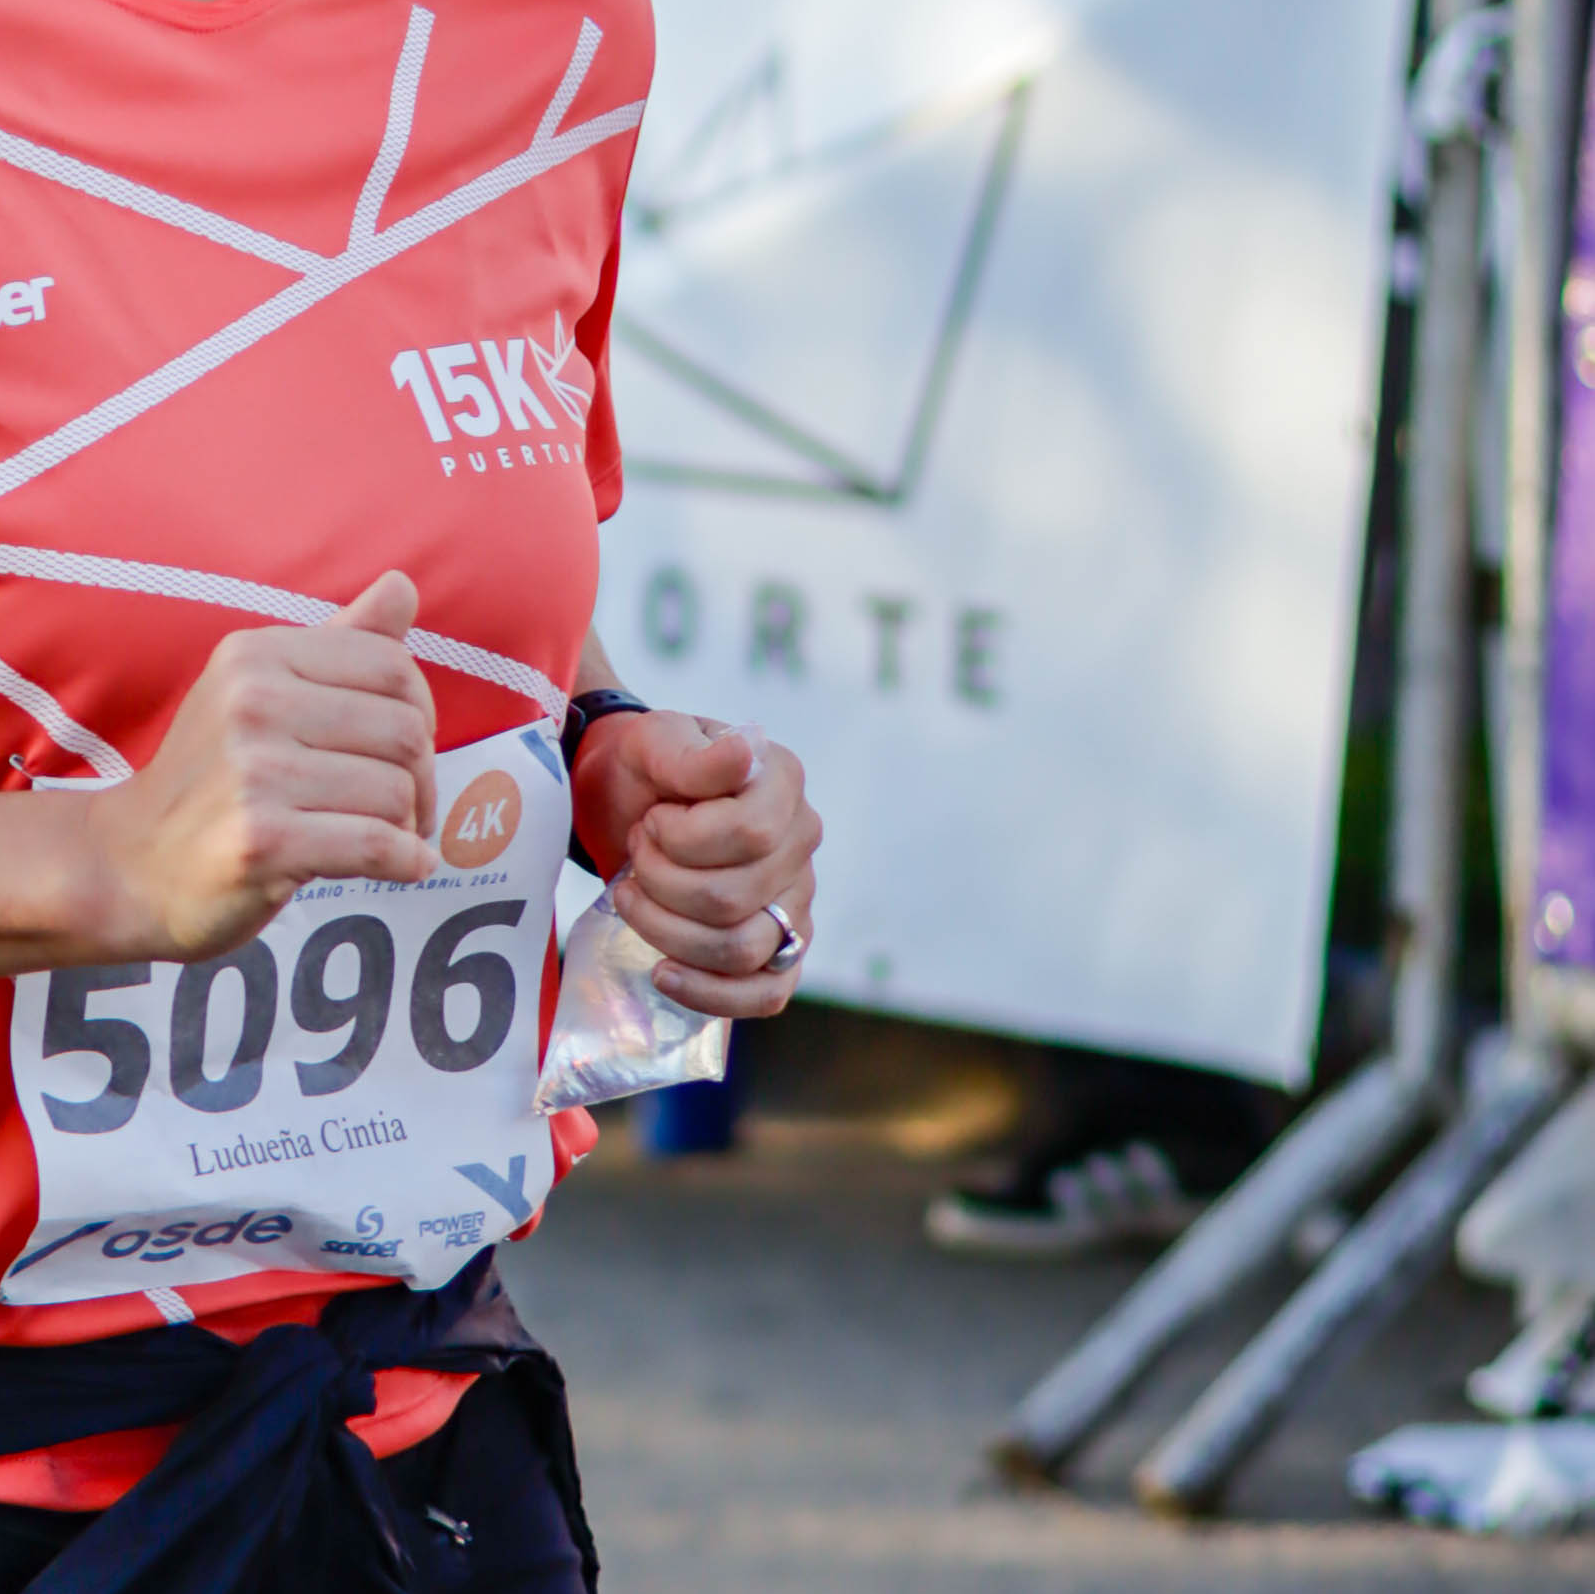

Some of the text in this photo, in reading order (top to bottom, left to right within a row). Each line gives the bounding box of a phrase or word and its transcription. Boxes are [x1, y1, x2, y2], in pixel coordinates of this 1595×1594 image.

[390, 337, 558, 443] 15K
[456, 798, 509, 843] 4K
[414, 877, 462, 891] ABRIL
[41, 900, 527, 1134] 5096
[187, 1110, 408, 1176] Ludueña Cintia
[102, 1210, 294, 1263] osde
[419, 1211, 485, 1237] POWER
